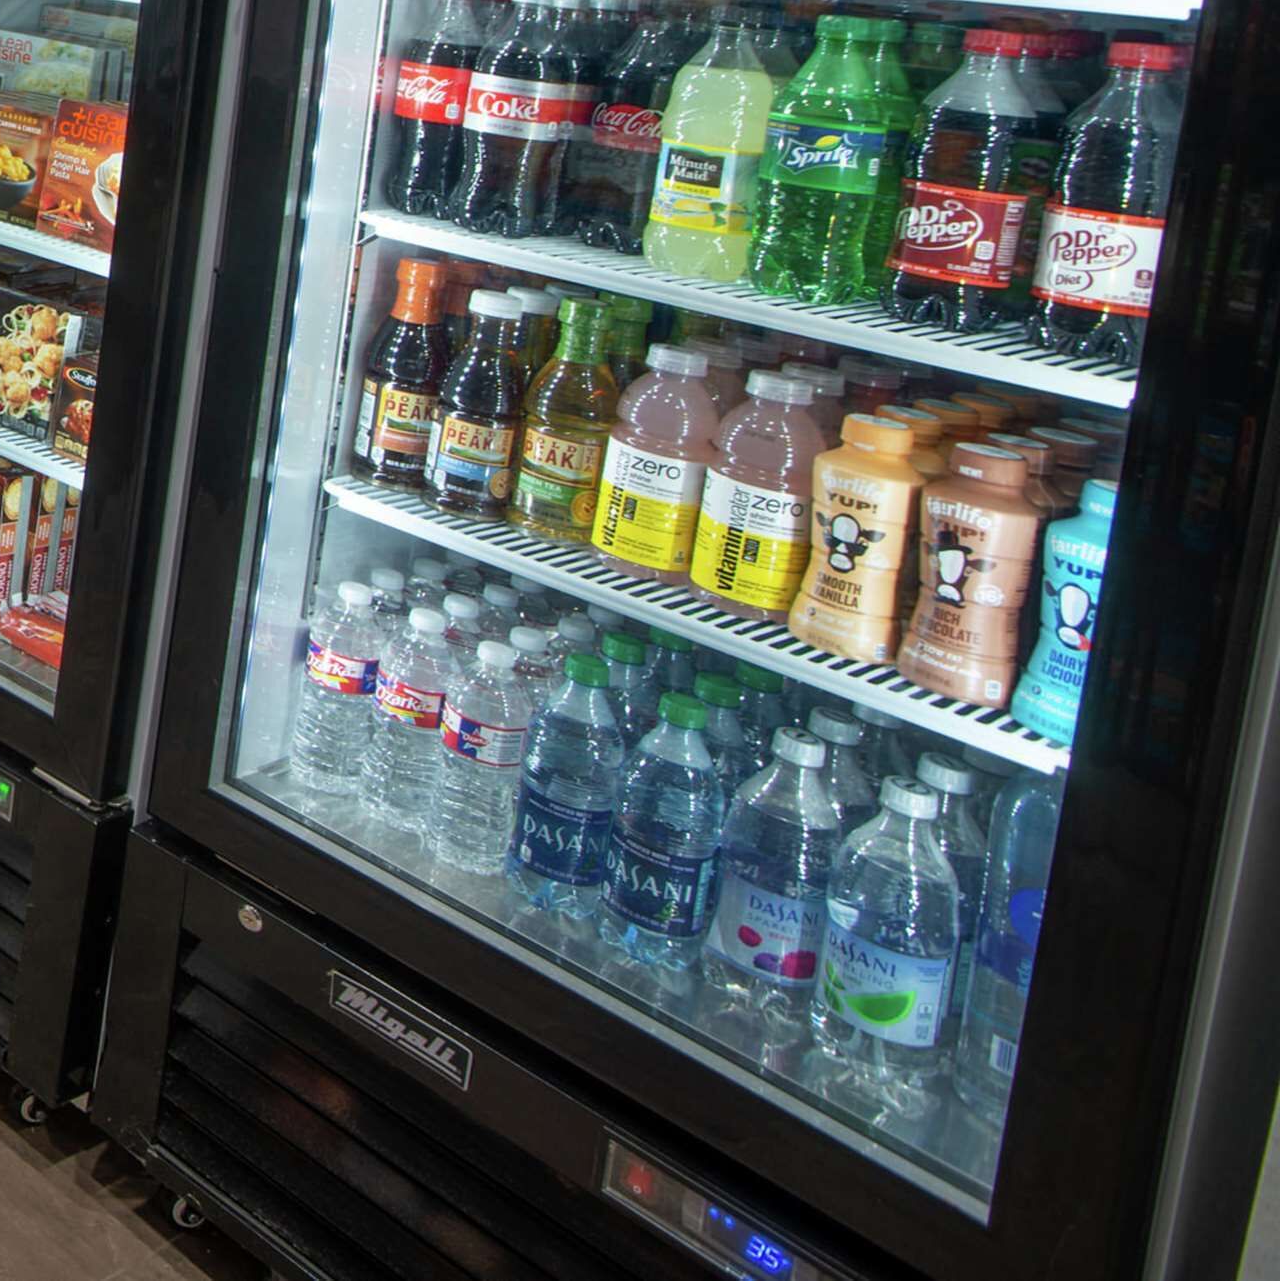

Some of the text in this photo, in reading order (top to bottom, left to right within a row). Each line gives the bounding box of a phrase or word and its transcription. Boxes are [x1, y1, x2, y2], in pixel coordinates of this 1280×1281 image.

[476, 91, 540, 120] Coke
[669, 154, 718, 173] Minute
[785, 144, 854, 169] Sprite
[672, 166, 709, 182] Maid
[899, 206, 977, 244] Pepper
[920, 204, 955, 225] Dr
[1050, 230, 1130, 266] Pepper
[1074, 229, 1107, 248] Dr
[1055, 272, 1082, 286] Diet
[383, 399, 436, 420] PEAK
[446, 427, 494, 451] PEAK
[631, 455, 681, 481] zero
[750, 494, 805, 519] zero
[1051, 534, 1107, 564] fairlif
[1054, 556, 1102, 580] YUP
[1042, 660, 1083, 687] LICIOU
[606, 849, 693, 904] DASANI
[748, 893, 819, 926] DASANI
[828, 929, 897, 978] DASANI
[339, 982, 461, 1075] Migali
[745, 1234, 780, 1269] 35
